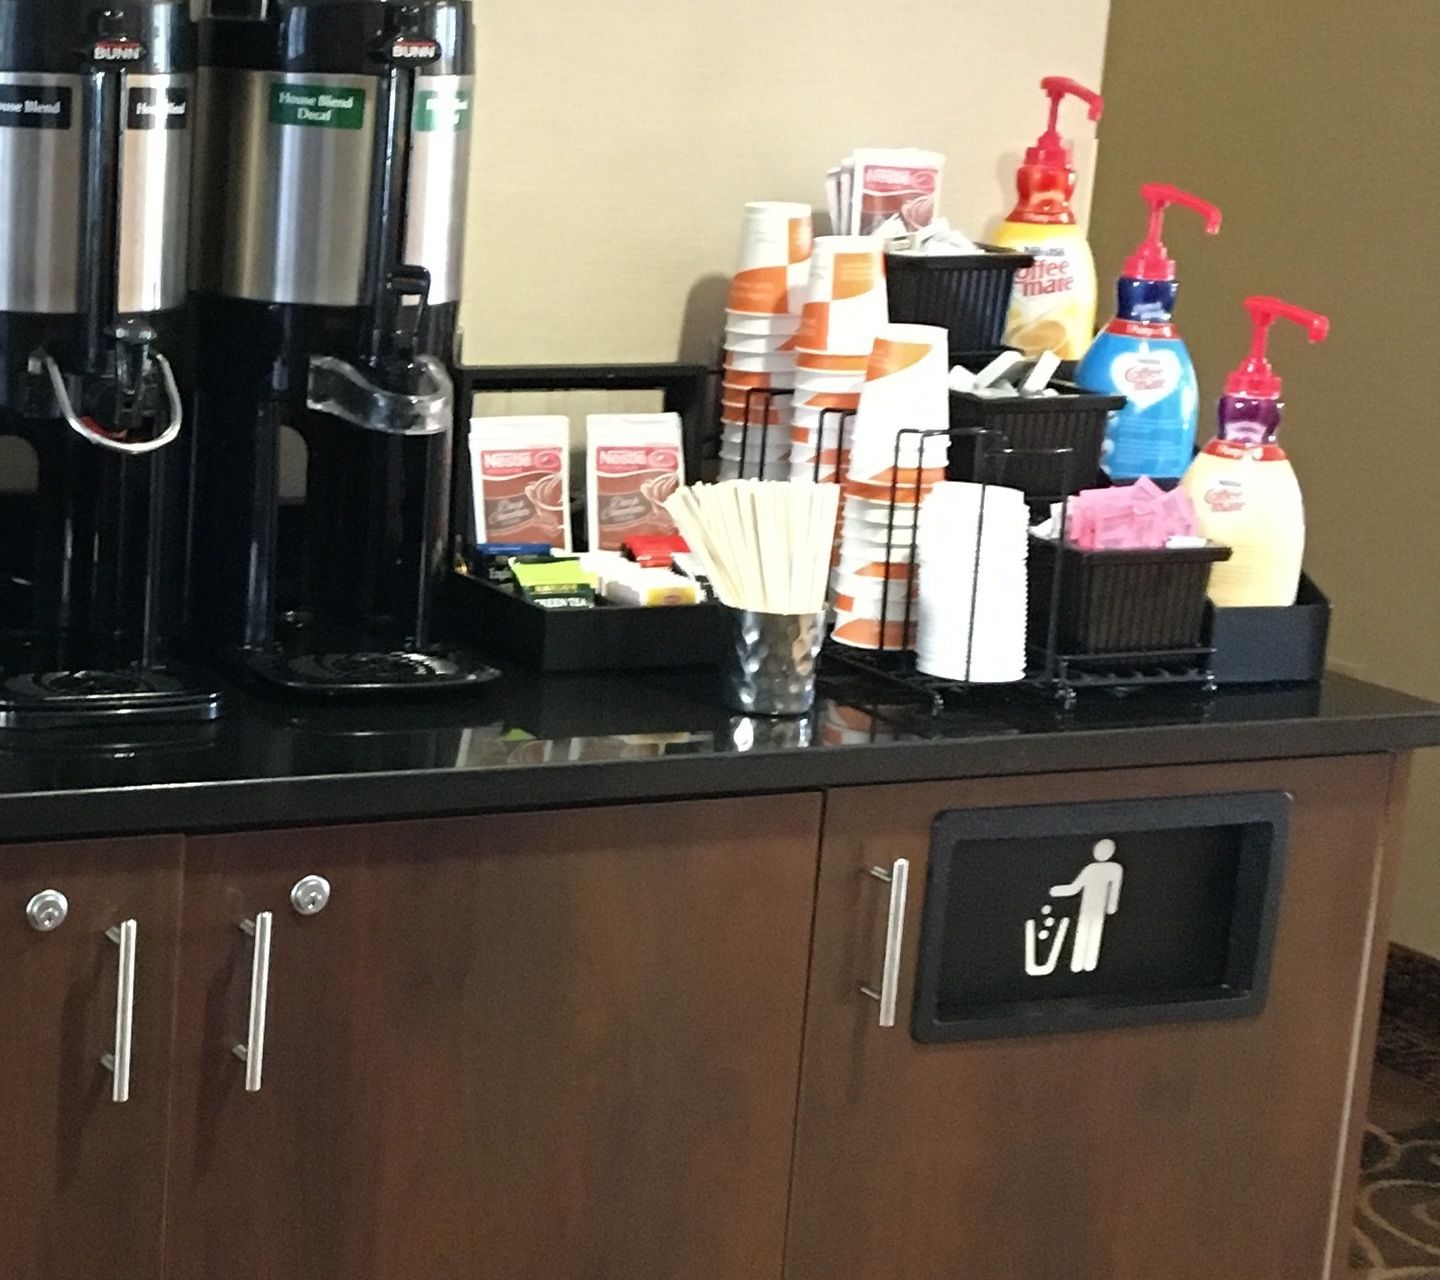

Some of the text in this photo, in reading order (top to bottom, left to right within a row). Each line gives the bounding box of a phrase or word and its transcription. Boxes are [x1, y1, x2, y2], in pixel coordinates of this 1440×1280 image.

[93, 46, 140, 60] BUNN
[392, 45, 436, 58] BUNN
[24, 99, 61, 114] Blend
[279, 91, 354, 109] House Blend
[296, 106, 332, 121] Decaf
